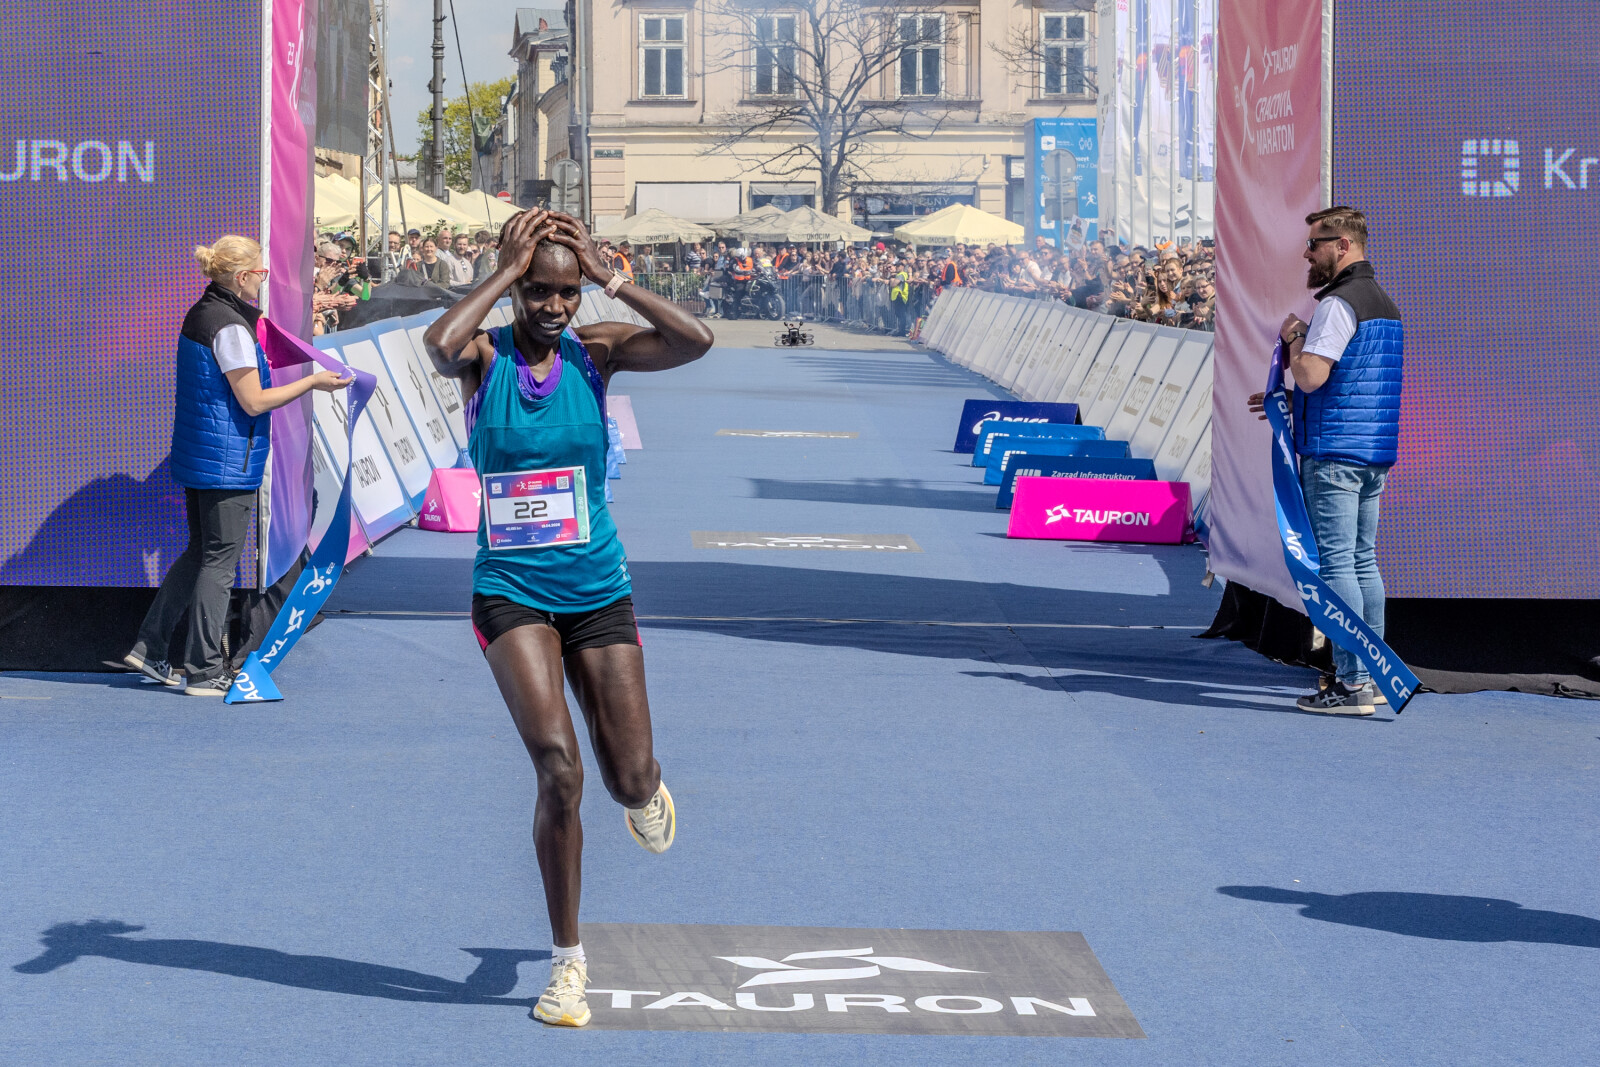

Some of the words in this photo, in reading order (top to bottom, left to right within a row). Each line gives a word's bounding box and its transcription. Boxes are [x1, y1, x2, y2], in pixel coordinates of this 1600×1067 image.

[1271, 43, 1299, 75] TAURON
[1255, 90, 1294, 122] CRACOVIA
[1256, 123, 1295, 155] MARATON
[806, 233, 831, 241] OKOCIM
[351, 454, 382, 489] TAURON
[1079, 471, 1136, 480] Infrastruktury
[424, 513, 441, 523] TAURON
[513, 499, 548, 519] 22
[1073, 508, 1150, 526] TAURON
[706, 541, 908, 550] TAURON
[1323, 599, 1392, 676] TAURON
[584, 988, 1097, 1017] TAURON
